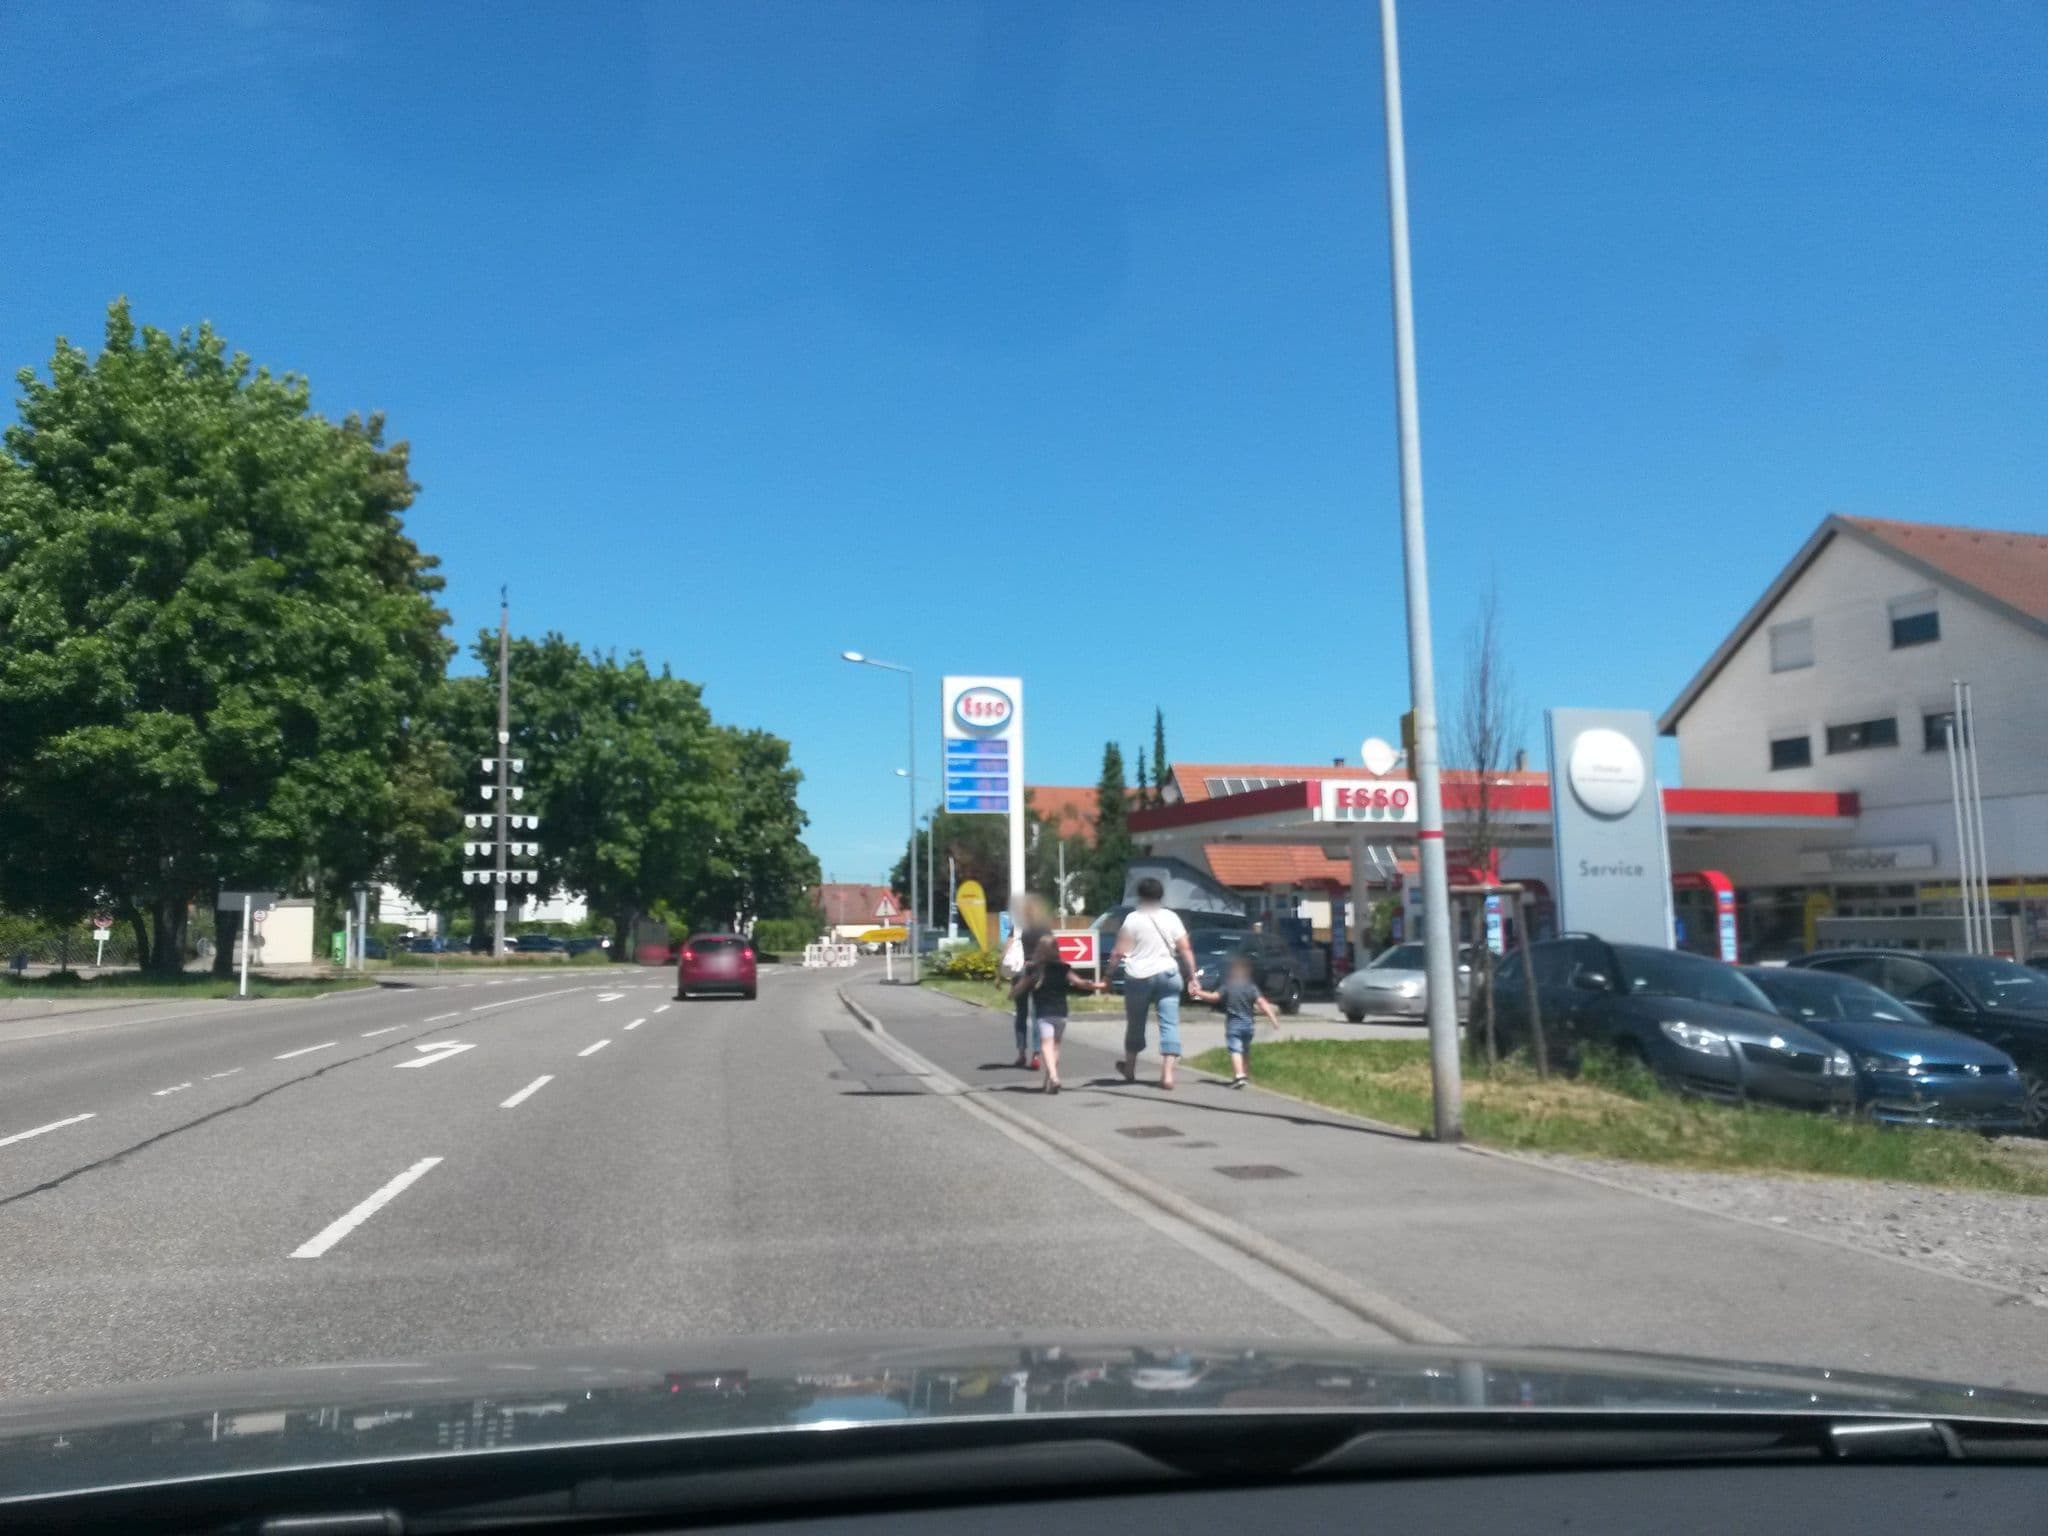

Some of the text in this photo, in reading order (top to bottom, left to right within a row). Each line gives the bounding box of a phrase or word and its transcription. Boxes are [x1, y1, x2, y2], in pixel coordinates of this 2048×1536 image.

[964, 697, 1005, 718] Esso
[1336, 788, 1409, 808] ESSO
[1579, 860, 1644, 877] Service
